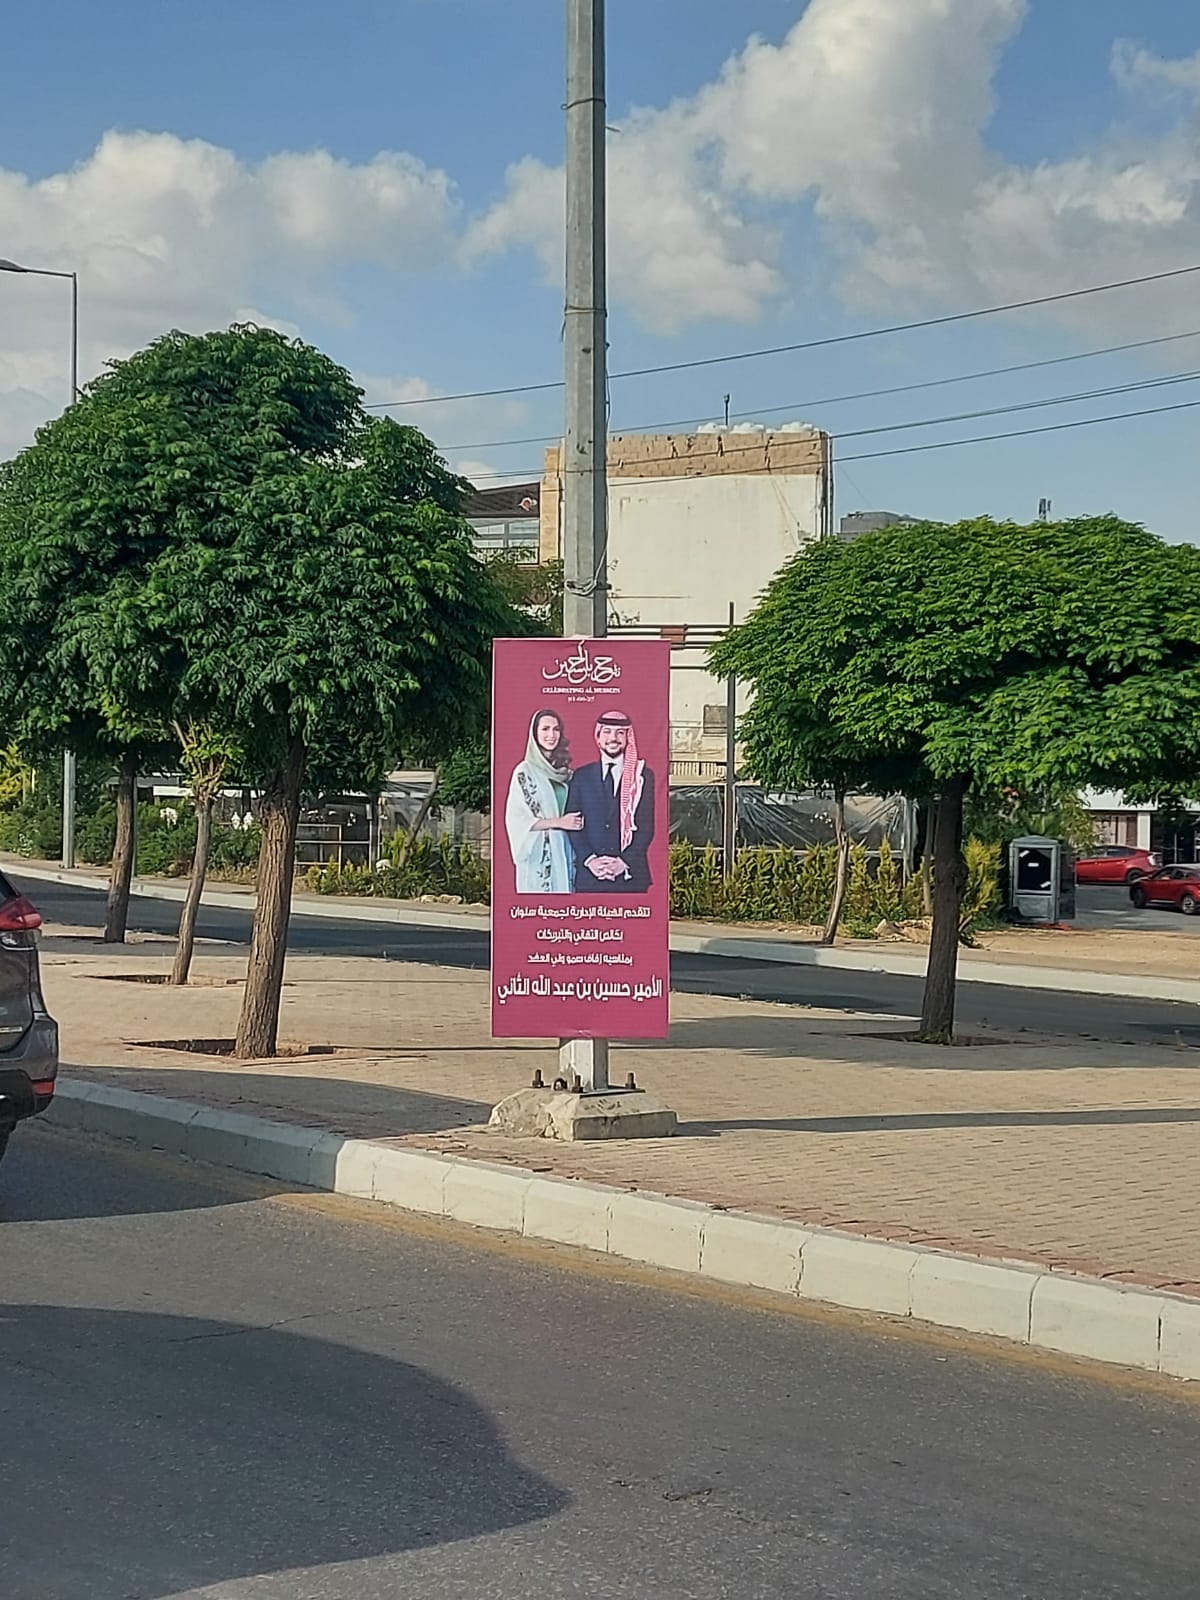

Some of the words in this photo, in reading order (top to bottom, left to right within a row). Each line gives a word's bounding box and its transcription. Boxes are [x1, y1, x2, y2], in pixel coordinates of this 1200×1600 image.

[497, 972, 530, 1004] الثاني
[531, 974, 551, 996] الله
[552, 982, 575, 1001] عبد
[576, 977, 592, 1001] بن
[594, 978, 631, 1001] حسين
[632, 974, 663, 1001] الأمير
